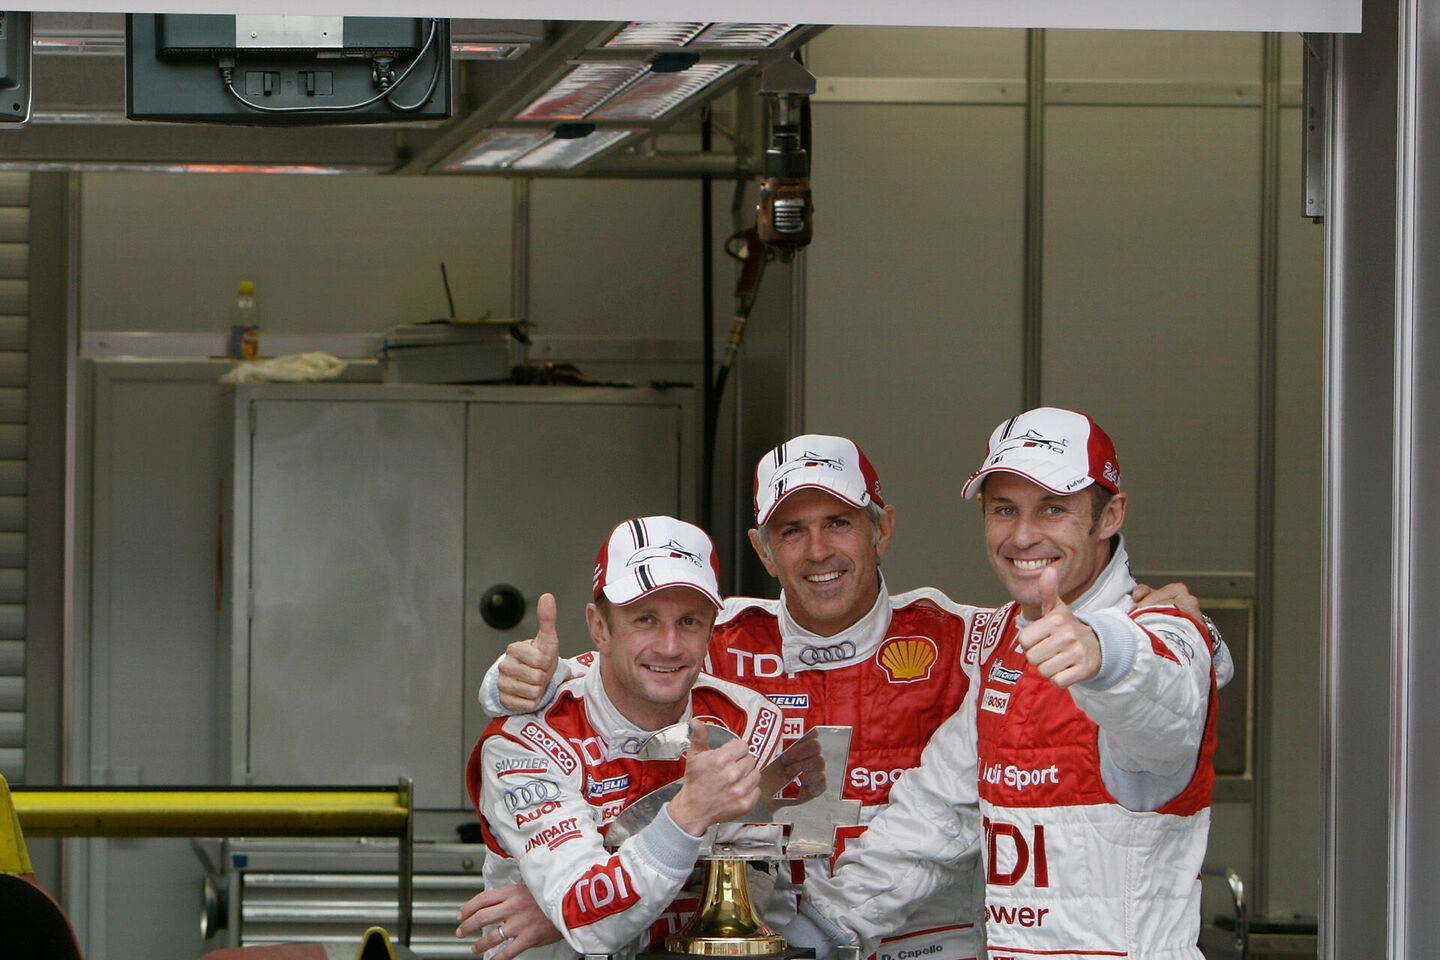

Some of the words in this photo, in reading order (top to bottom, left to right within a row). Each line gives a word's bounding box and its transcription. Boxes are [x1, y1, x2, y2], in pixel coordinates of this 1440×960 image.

[727, 647, 795, 679] TD
[748, 709, 773, 760] parco
[495, 757, 549, 774] SANDTLER
[850, 767, 905, 791] Spo
[1004, 763, 1060, 791] Sport
[524, 818, 578, 854] UNIPART
[983, 816, 1050, 889] DI
[898, 944, 944, 960] Capello
